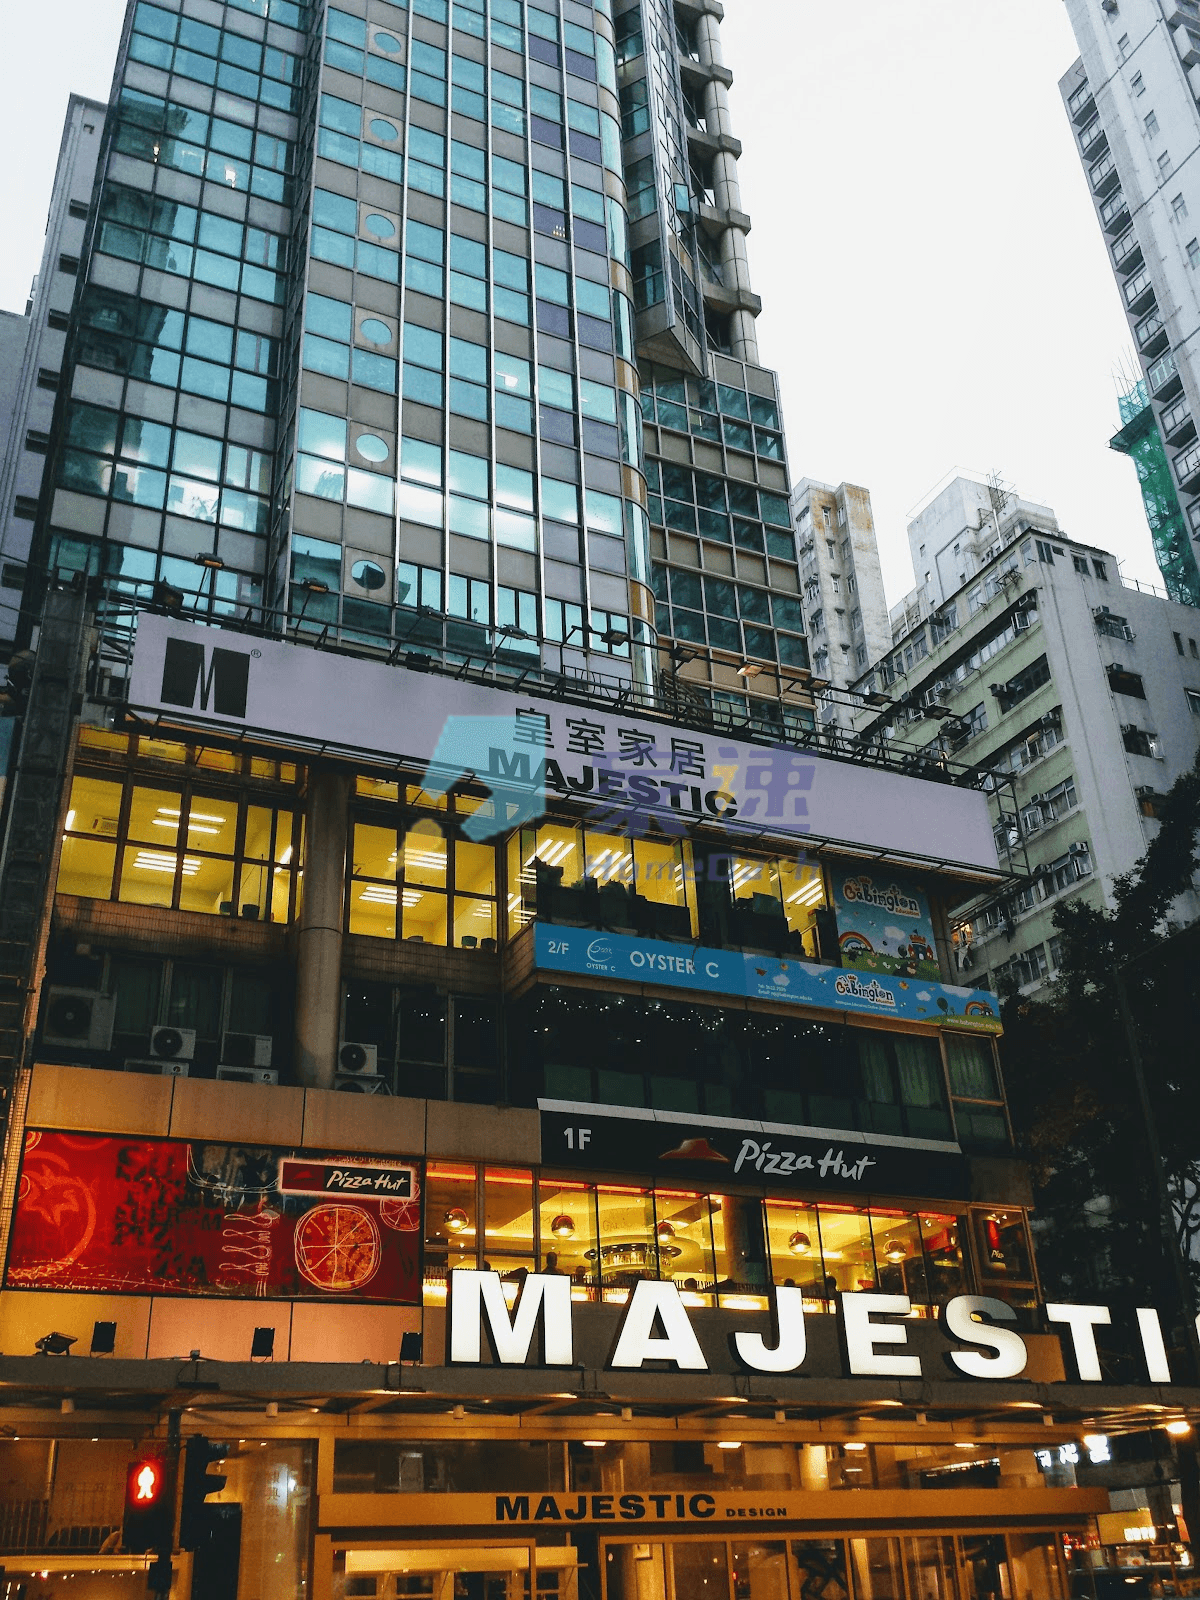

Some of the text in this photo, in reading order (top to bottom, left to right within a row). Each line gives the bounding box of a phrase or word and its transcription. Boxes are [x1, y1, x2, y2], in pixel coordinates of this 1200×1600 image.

[512, 707, 706, 780] 皇室家居
[488, 747, 738, 818] MAJESTIC
[844, 879, 918, 911] Babington
[548, 941, 570, 955] 2/F
[586, 962, 608, 971] OYSTER
[630, 951, 720, 978] OYSTER C
[836, 977, 894, 1001] Babington
[563, 1127, 592, 1150] 1F
[733, 1139, 876, 1181] Pizza Hut
[326, 1170, 408, 1190] Pizza Hut
[450, 1269, 1200, 1383] MAJESTI
[495, 1494, 787, 1520] MAJESTIC DESIGN
